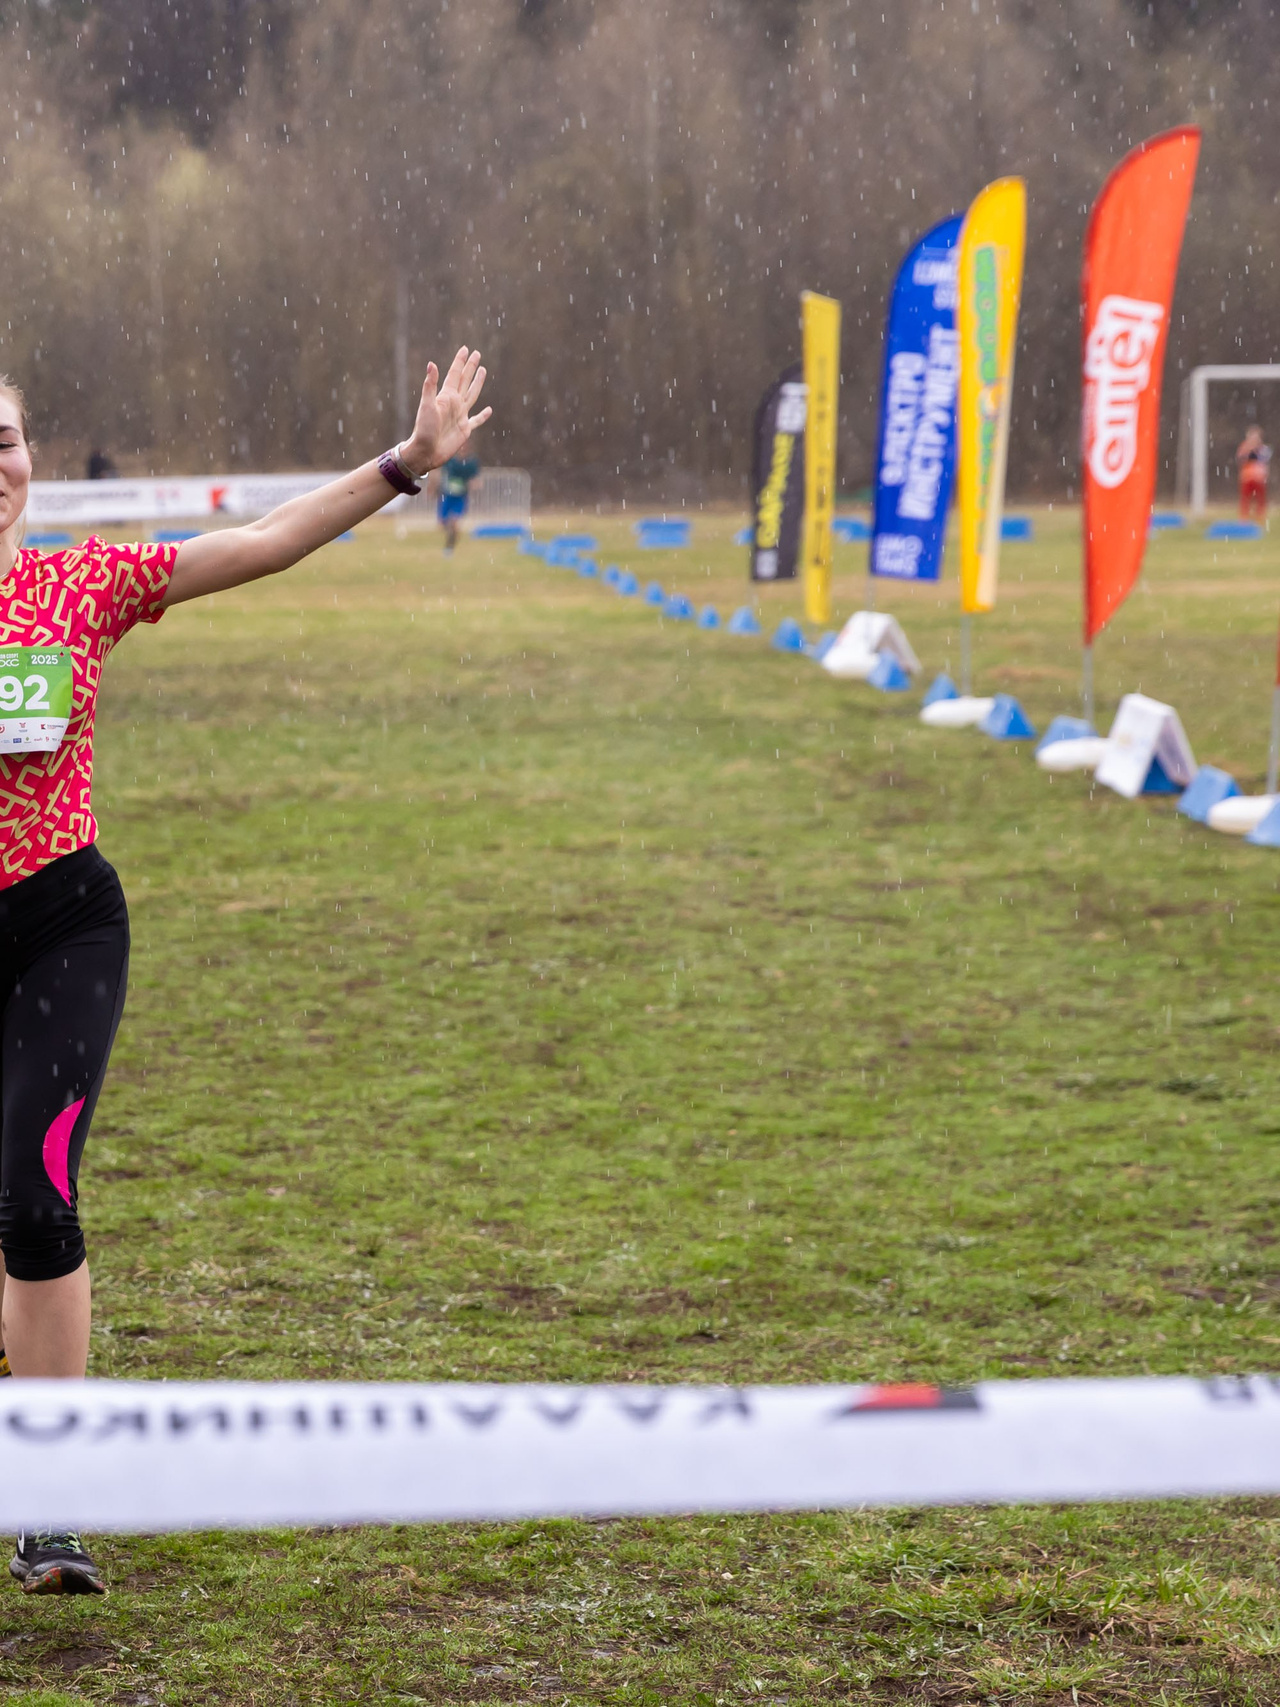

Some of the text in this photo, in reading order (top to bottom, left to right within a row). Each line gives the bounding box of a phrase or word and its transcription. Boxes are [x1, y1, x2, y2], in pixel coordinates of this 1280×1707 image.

[880, 353, 927, 487] ЭЛЕКТРО
[896, 322, 960, 520] ИНСТРУМЕНТ
[31, 654, 59, 665] 2025
